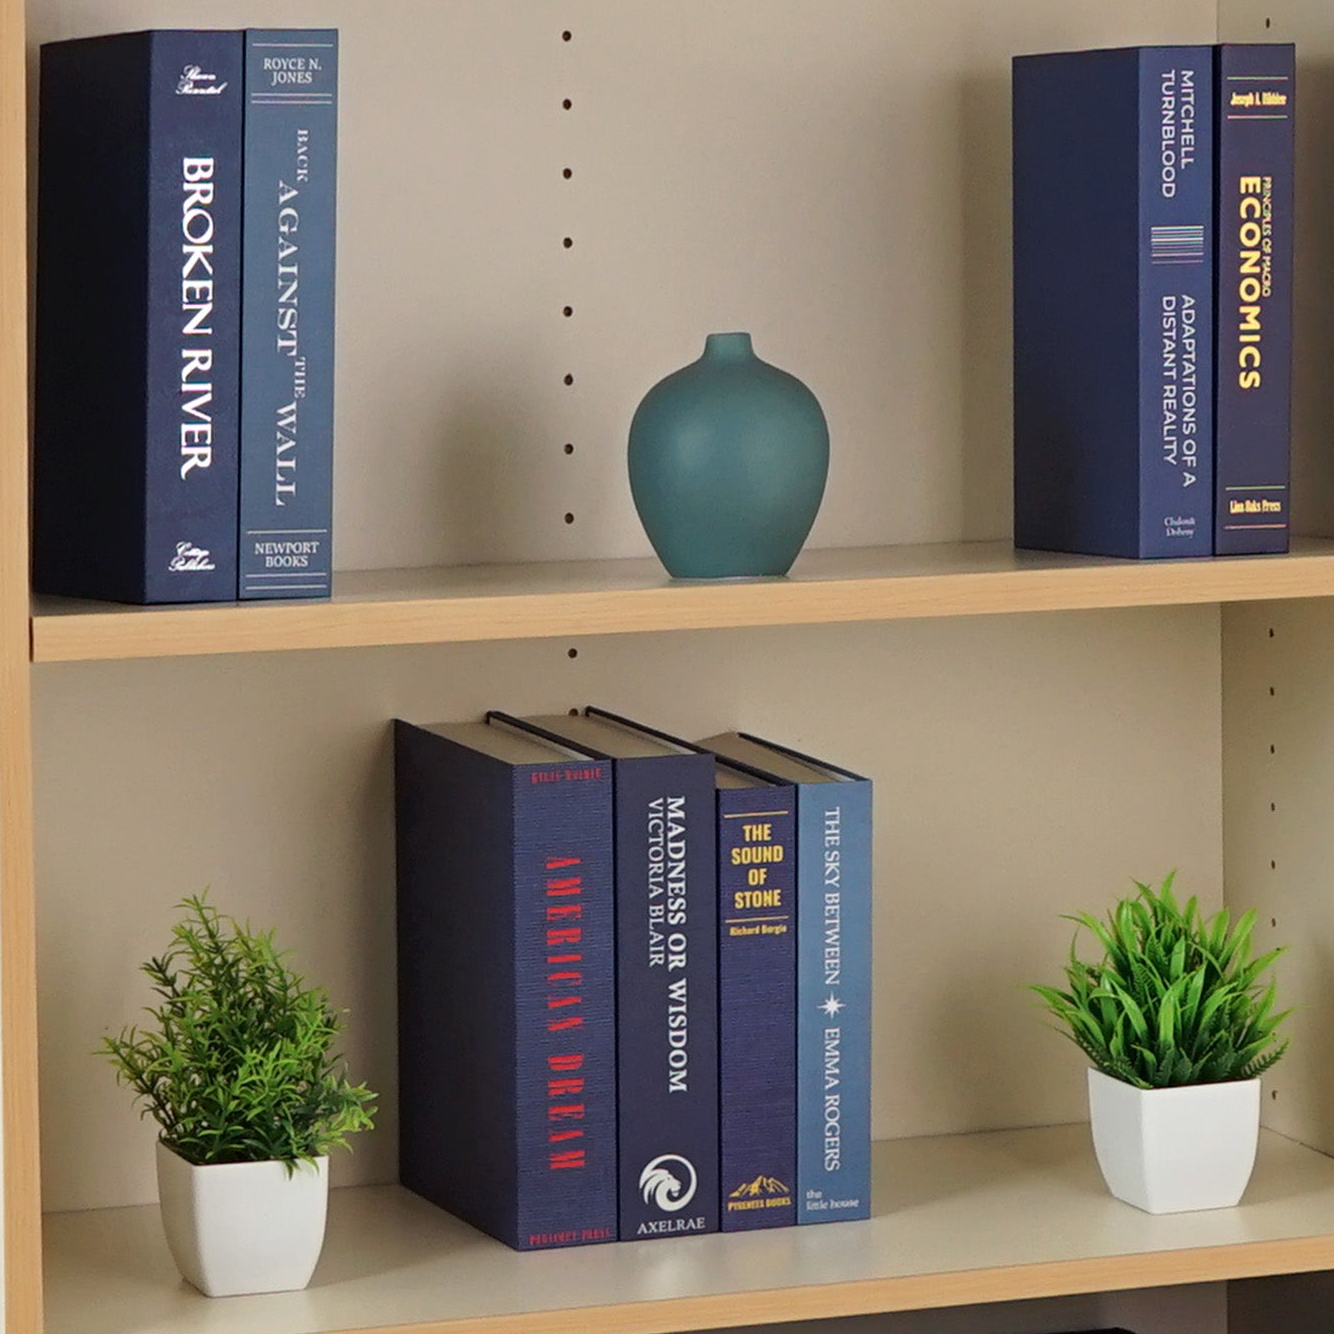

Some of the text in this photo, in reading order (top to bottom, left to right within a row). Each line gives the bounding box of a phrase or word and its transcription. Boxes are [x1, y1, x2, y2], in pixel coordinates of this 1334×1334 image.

[263, 58, 322, 70] ROYCE N.
[272, 71, 312, 86] JONES
[1162, 70, 1175, 197] TURNBLOOD
[1181, 71, 1194, 169] MITCHELL
[1239, 177, 1261, 388] ECONOMICS
[1262, 176, 1272, 297] PRINCIPLES OF MACRO
[181, 158, 214, 479] BROKEN RIVER
[275, 130, 308, 506] BACK AGAINST THE WALL
[1162, 296, 1177, 464] DISTANT REALITY
[1182, 295, 1196, 486] ADAPTATIONS OF A
[255, 541, 320, 555] NEWPORT
[265, 555, 308, 568] BOOKS
[649, 798, 664, 967] VICTORIA BLAIR
[731, 844, 784, 866] SOUND
[743, 824, 771, 841] THE
[749, 868, 767, 885] OF
[667, 796, 687, 1092] MADNESS OR WISDOM
[734, 891, 782, 909] STONE
[824, 806, 840, 984] THE SKY BETWEEN
[546, 857, 585, 1169] AMERICAN DREAM
[825, 1028, 840, 1171] EMMA ROGERS
[637, 1216, 706, 1235] AXELRAE
[807, 1189, 822, 1199] the
[807, 1198, 859, 1210] little house
